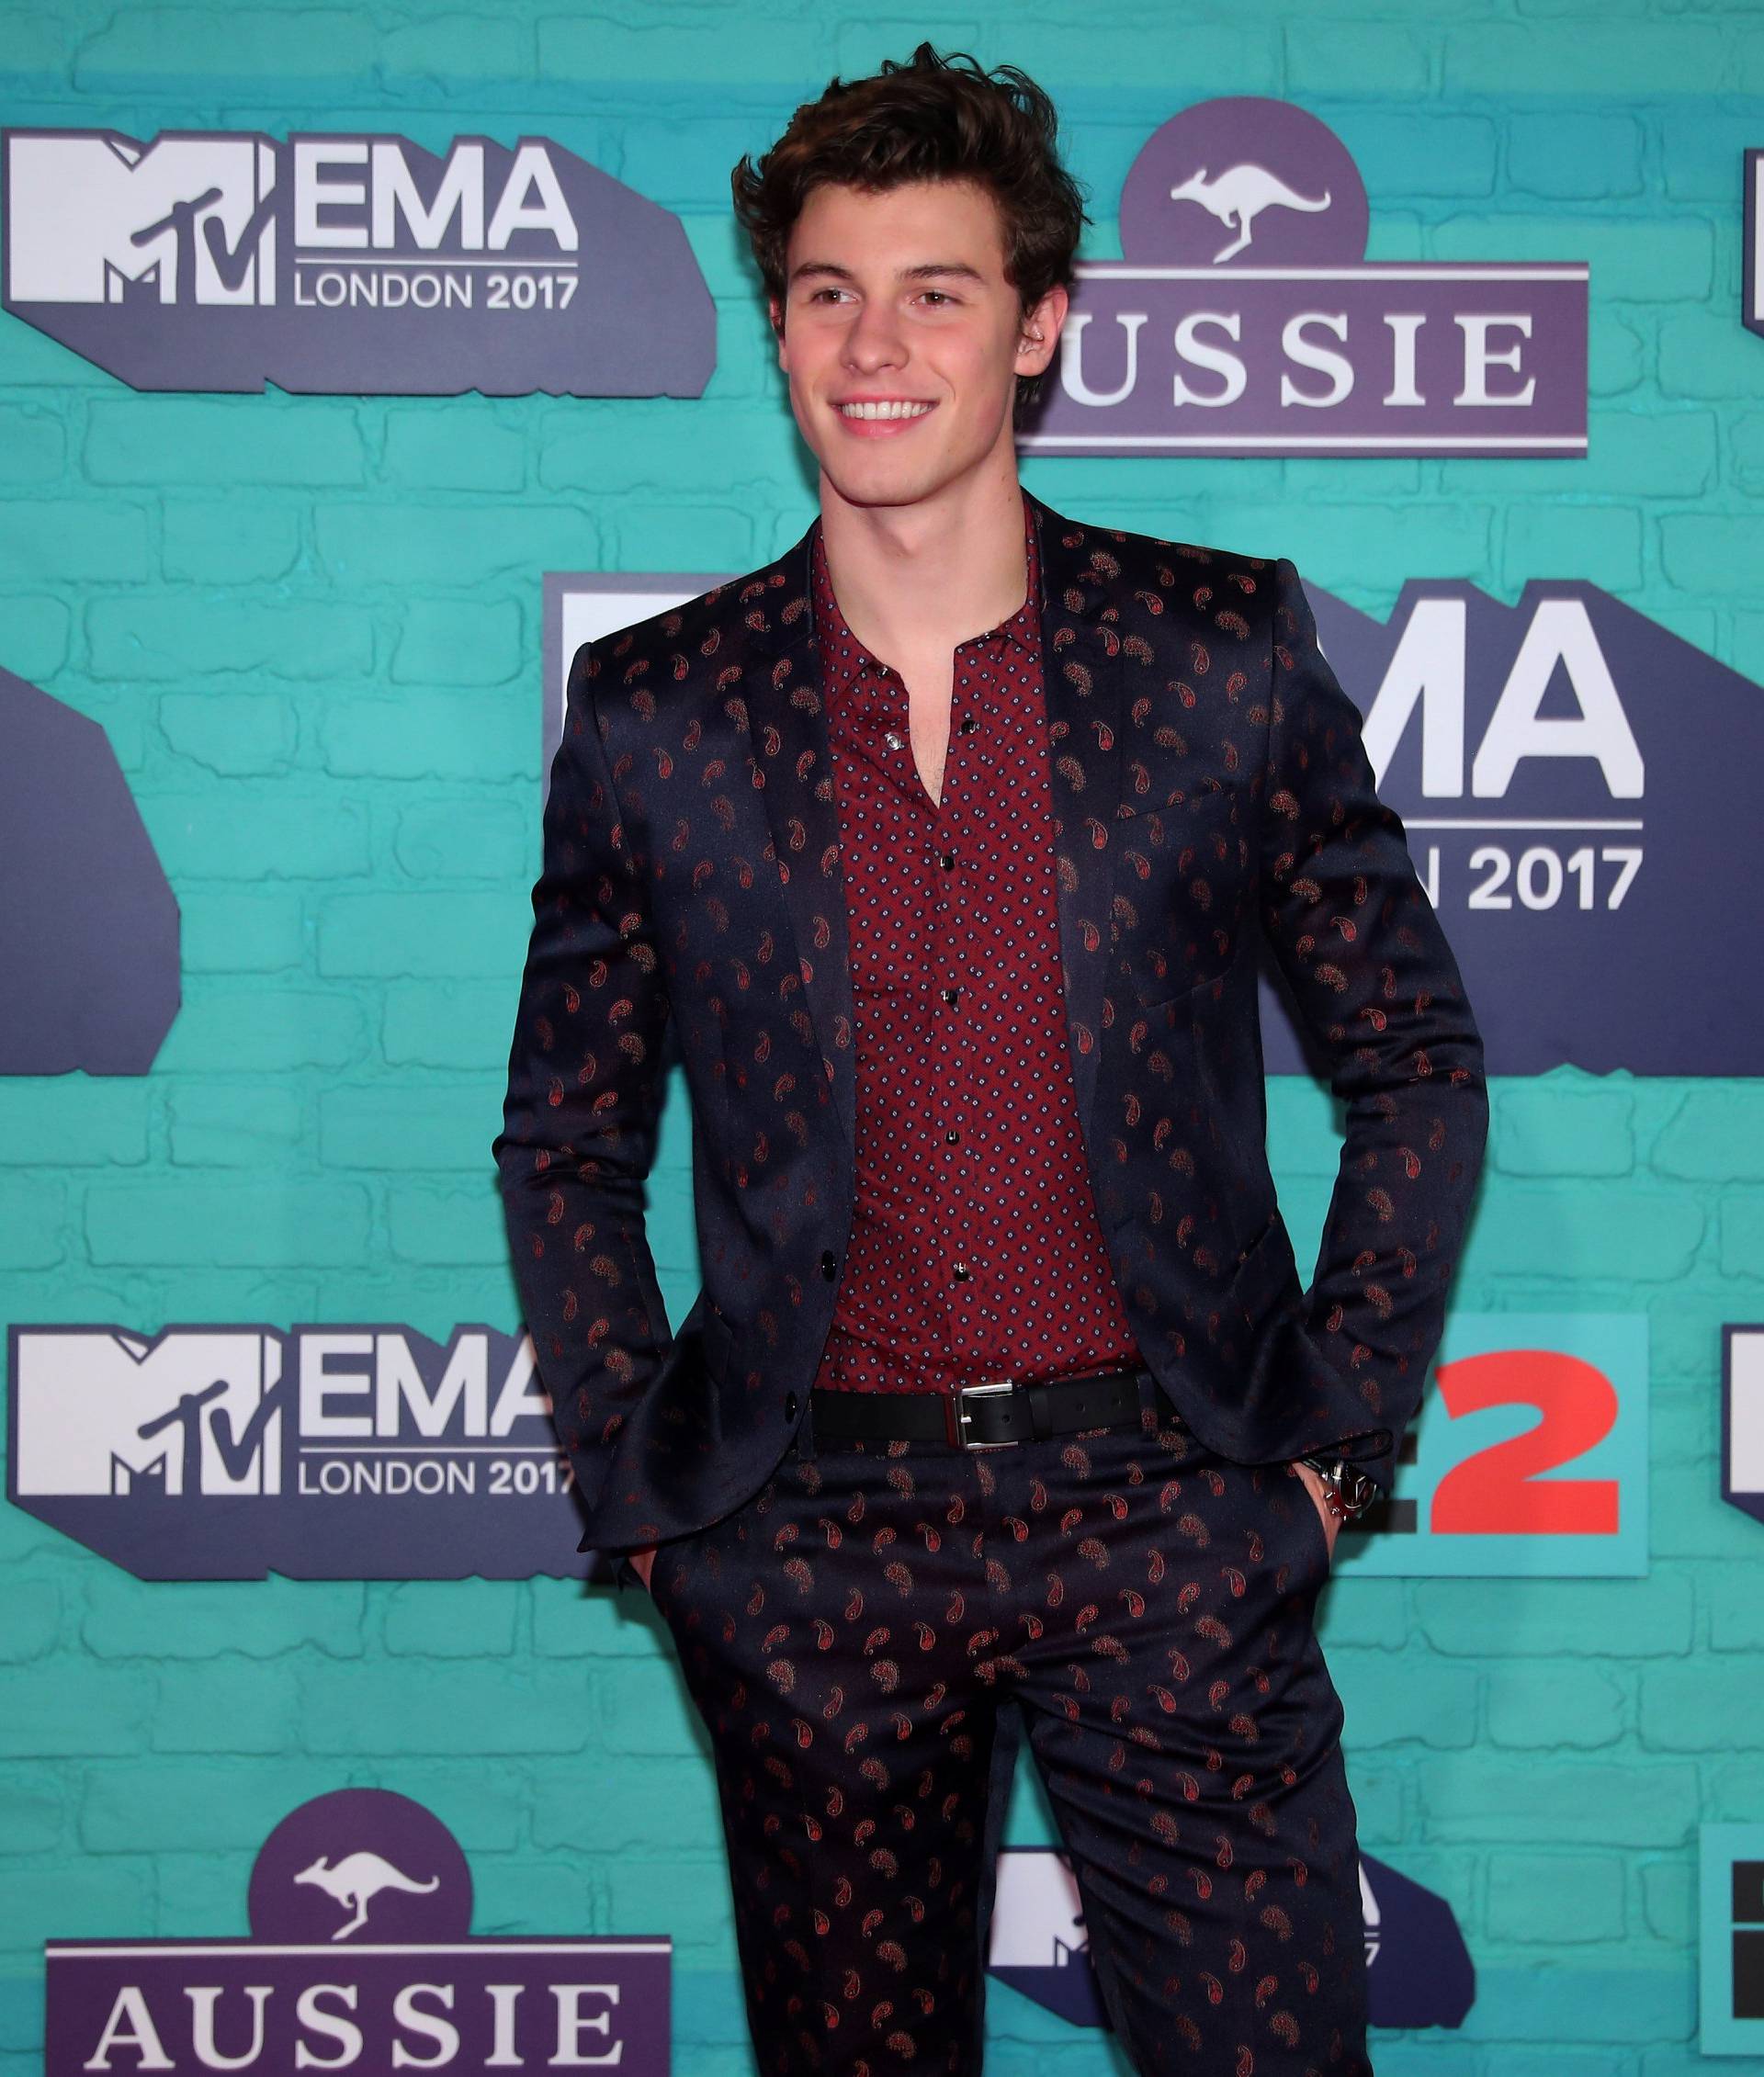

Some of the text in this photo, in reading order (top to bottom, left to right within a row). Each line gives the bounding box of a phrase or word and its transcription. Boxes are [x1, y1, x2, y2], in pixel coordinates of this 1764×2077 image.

[8, 137, 277, 307] MTV
[293, 141, 580, 253] EMA
[293, 272, 579, 311] LONDON 2017
[1058, 309, 1538, 410] USSIE
[1316, 597, 1645, 799] MA
[1467, 846, 1645, 911] 2017
[16, 1333, 283, 1496] MTV
[1346, 1348, 1620, 1535] 2
[298, 1460, 477, 1496] LONDON
[83, 1982, 624, 2071] AUSSIE
